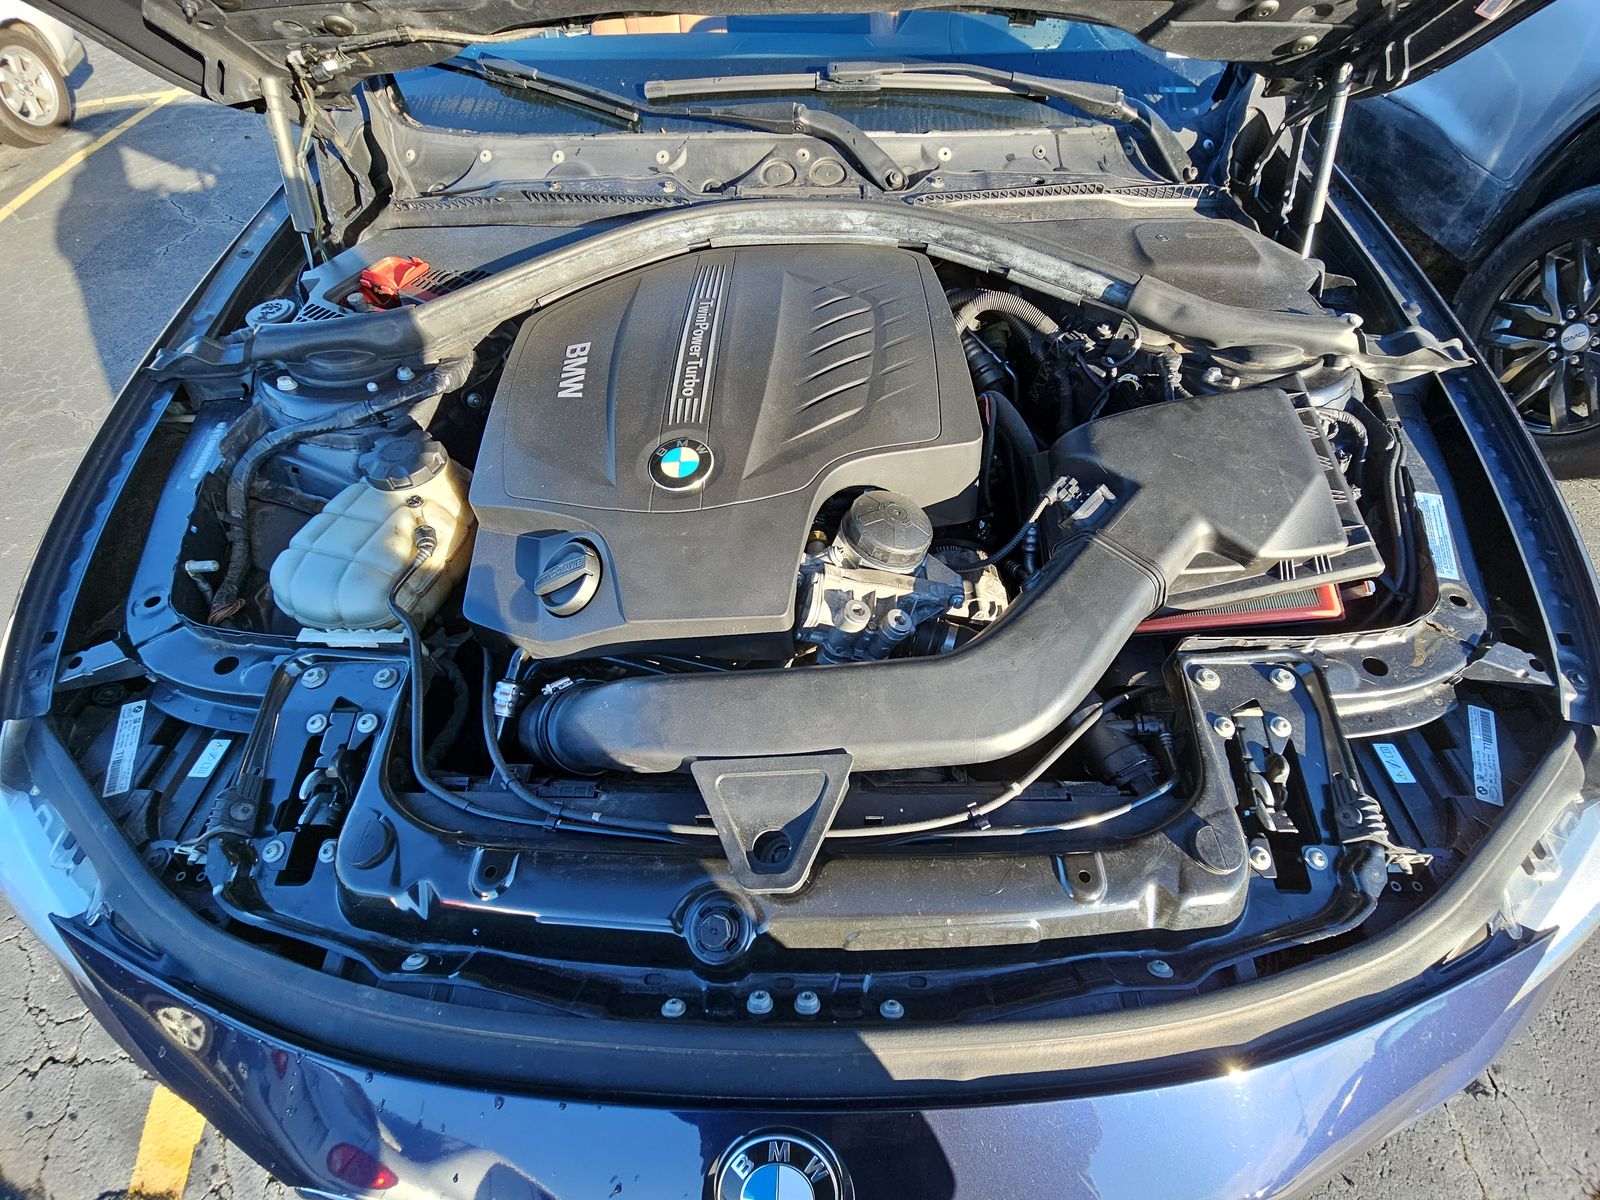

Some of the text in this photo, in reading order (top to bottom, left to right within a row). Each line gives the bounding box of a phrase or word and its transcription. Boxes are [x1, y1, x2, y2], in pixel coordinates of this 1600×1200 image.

[681, 299, 714, 397] TwinPower Turbo
[1563, 330, 1586, 343] GMC
[557, 341, 592, 398] BMW
[656, 439, 709, 457] BMW
[730, 1140, 829, 1182] BMW
